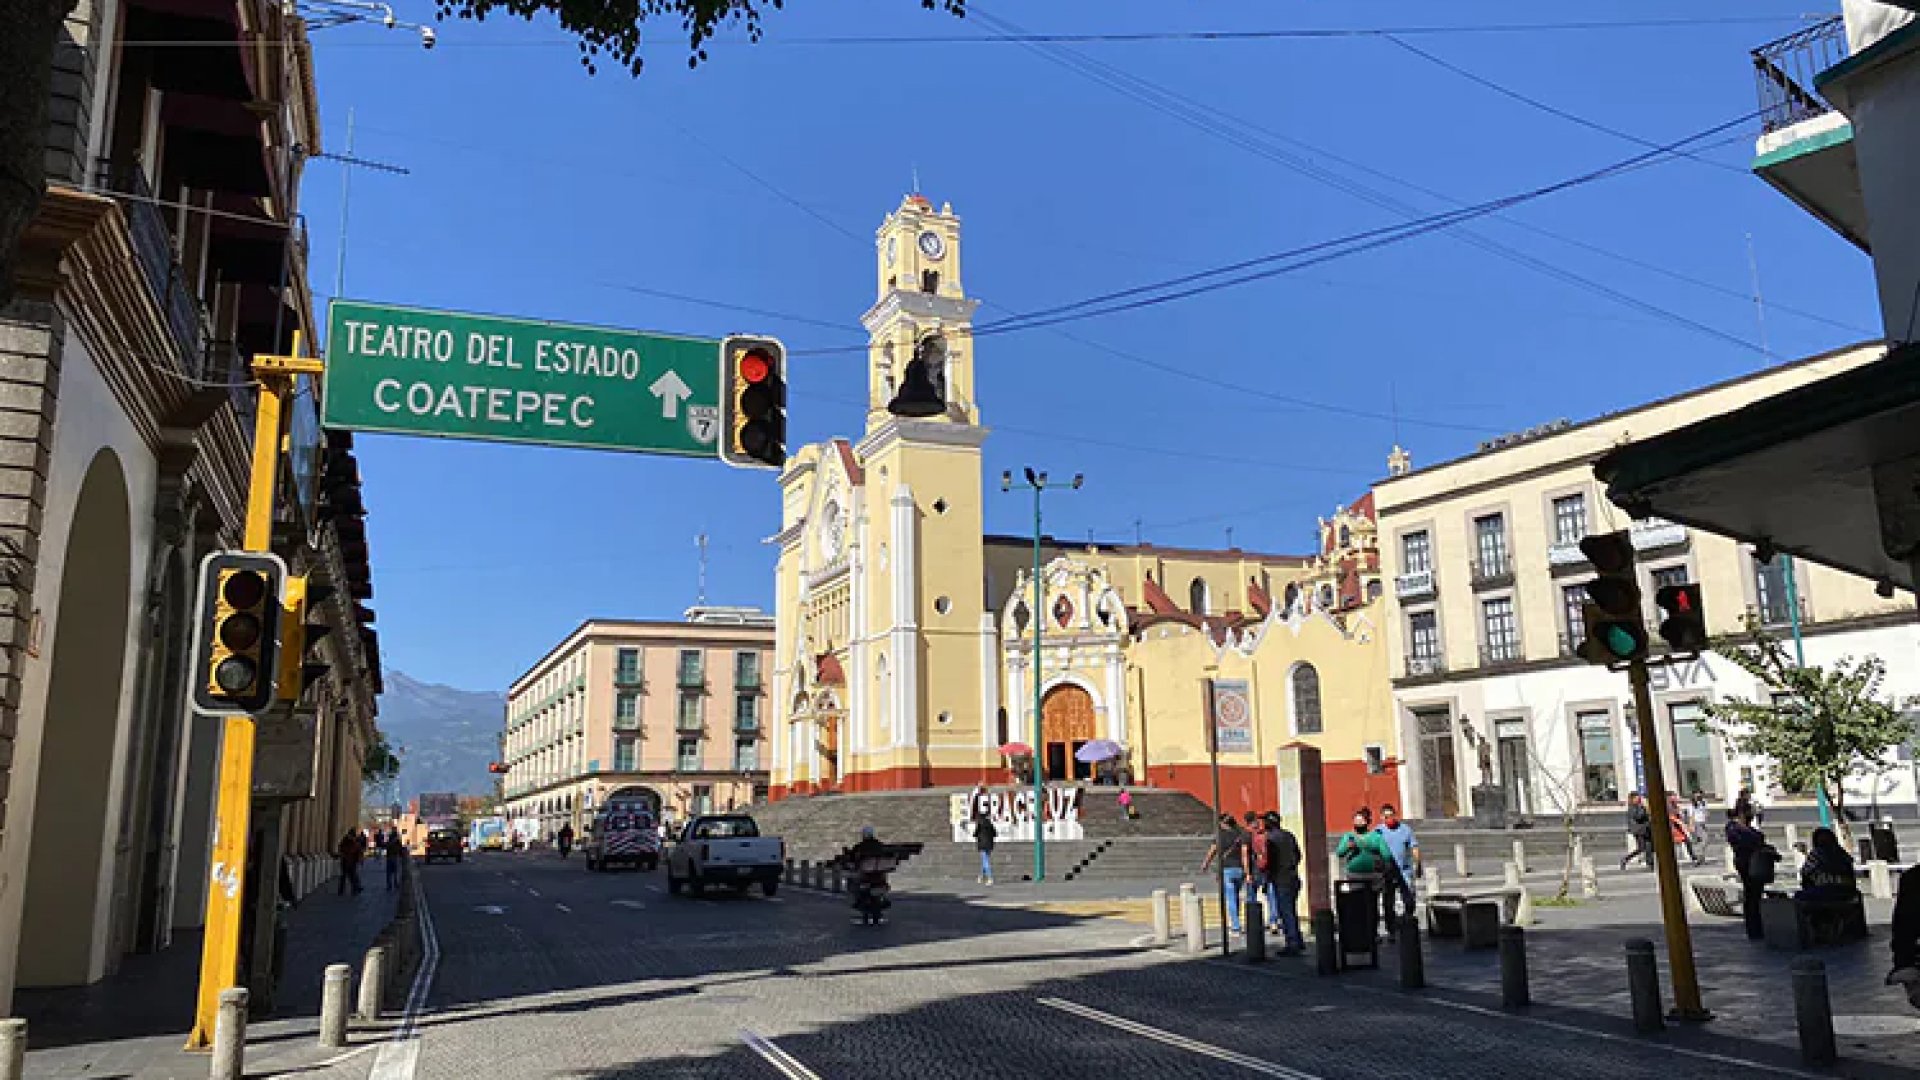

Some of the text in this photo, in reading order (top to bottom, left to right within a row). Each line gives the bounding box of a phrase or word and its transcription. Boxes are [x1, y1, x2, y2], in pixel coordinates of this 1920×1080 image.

[344, 320, 639, 379] TEATRO DEL ESTADO
[373, 378, 594, 428] COATEPEC
[698, 419, 710, 438] 7
[1651, 657, 1717, 691] BVA
